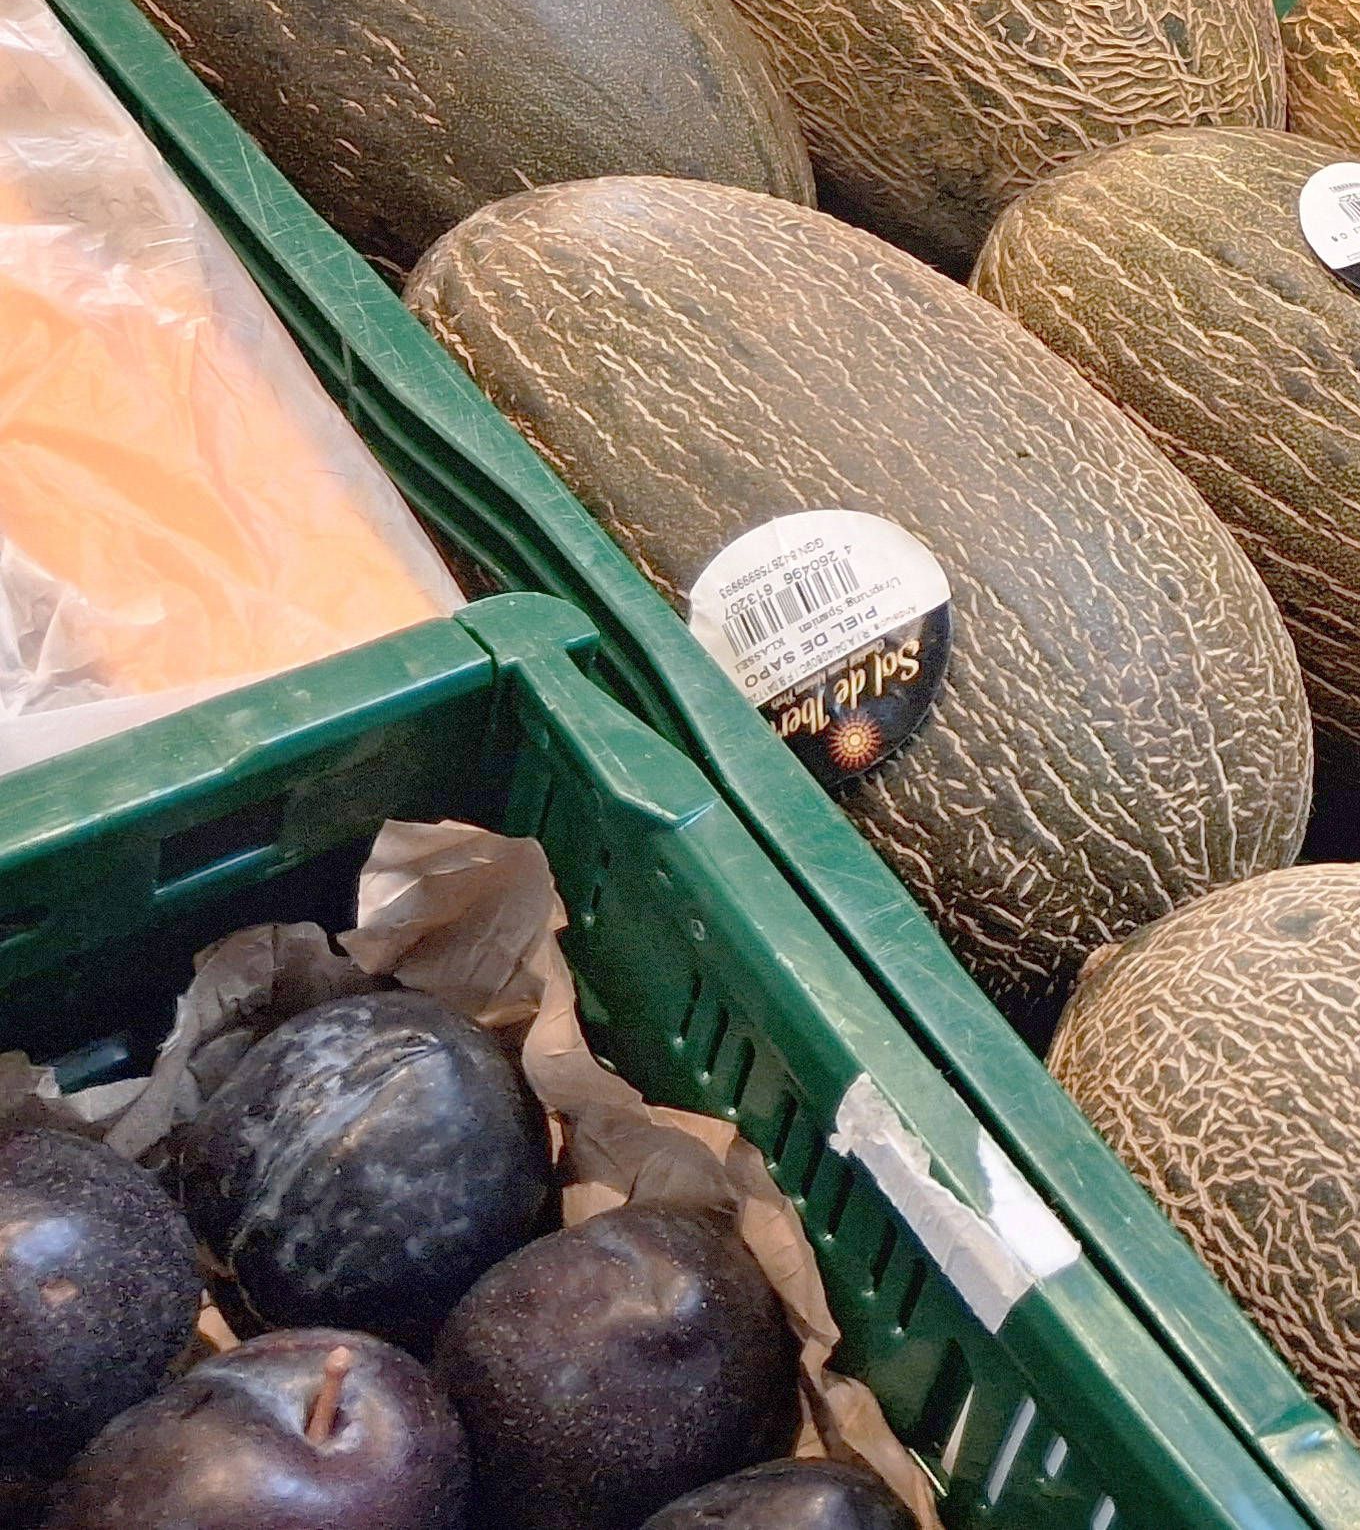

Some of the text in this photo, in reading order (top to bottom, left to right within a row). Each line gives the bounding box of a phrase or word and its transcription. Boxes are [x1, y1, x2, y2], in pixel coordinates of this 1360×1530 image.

[783, 549, 838, 586] 260496
[724, 583, 774, 620] 613207
[839, 606, 879, 633] PIEL
[802, 634, 829, 655] DE
[744, 650, 796, 688] SAPO
[875, 638, 920, 697] Sol
[834, 667, 867, 709] de
[770, 693, 831, 738] Iber
